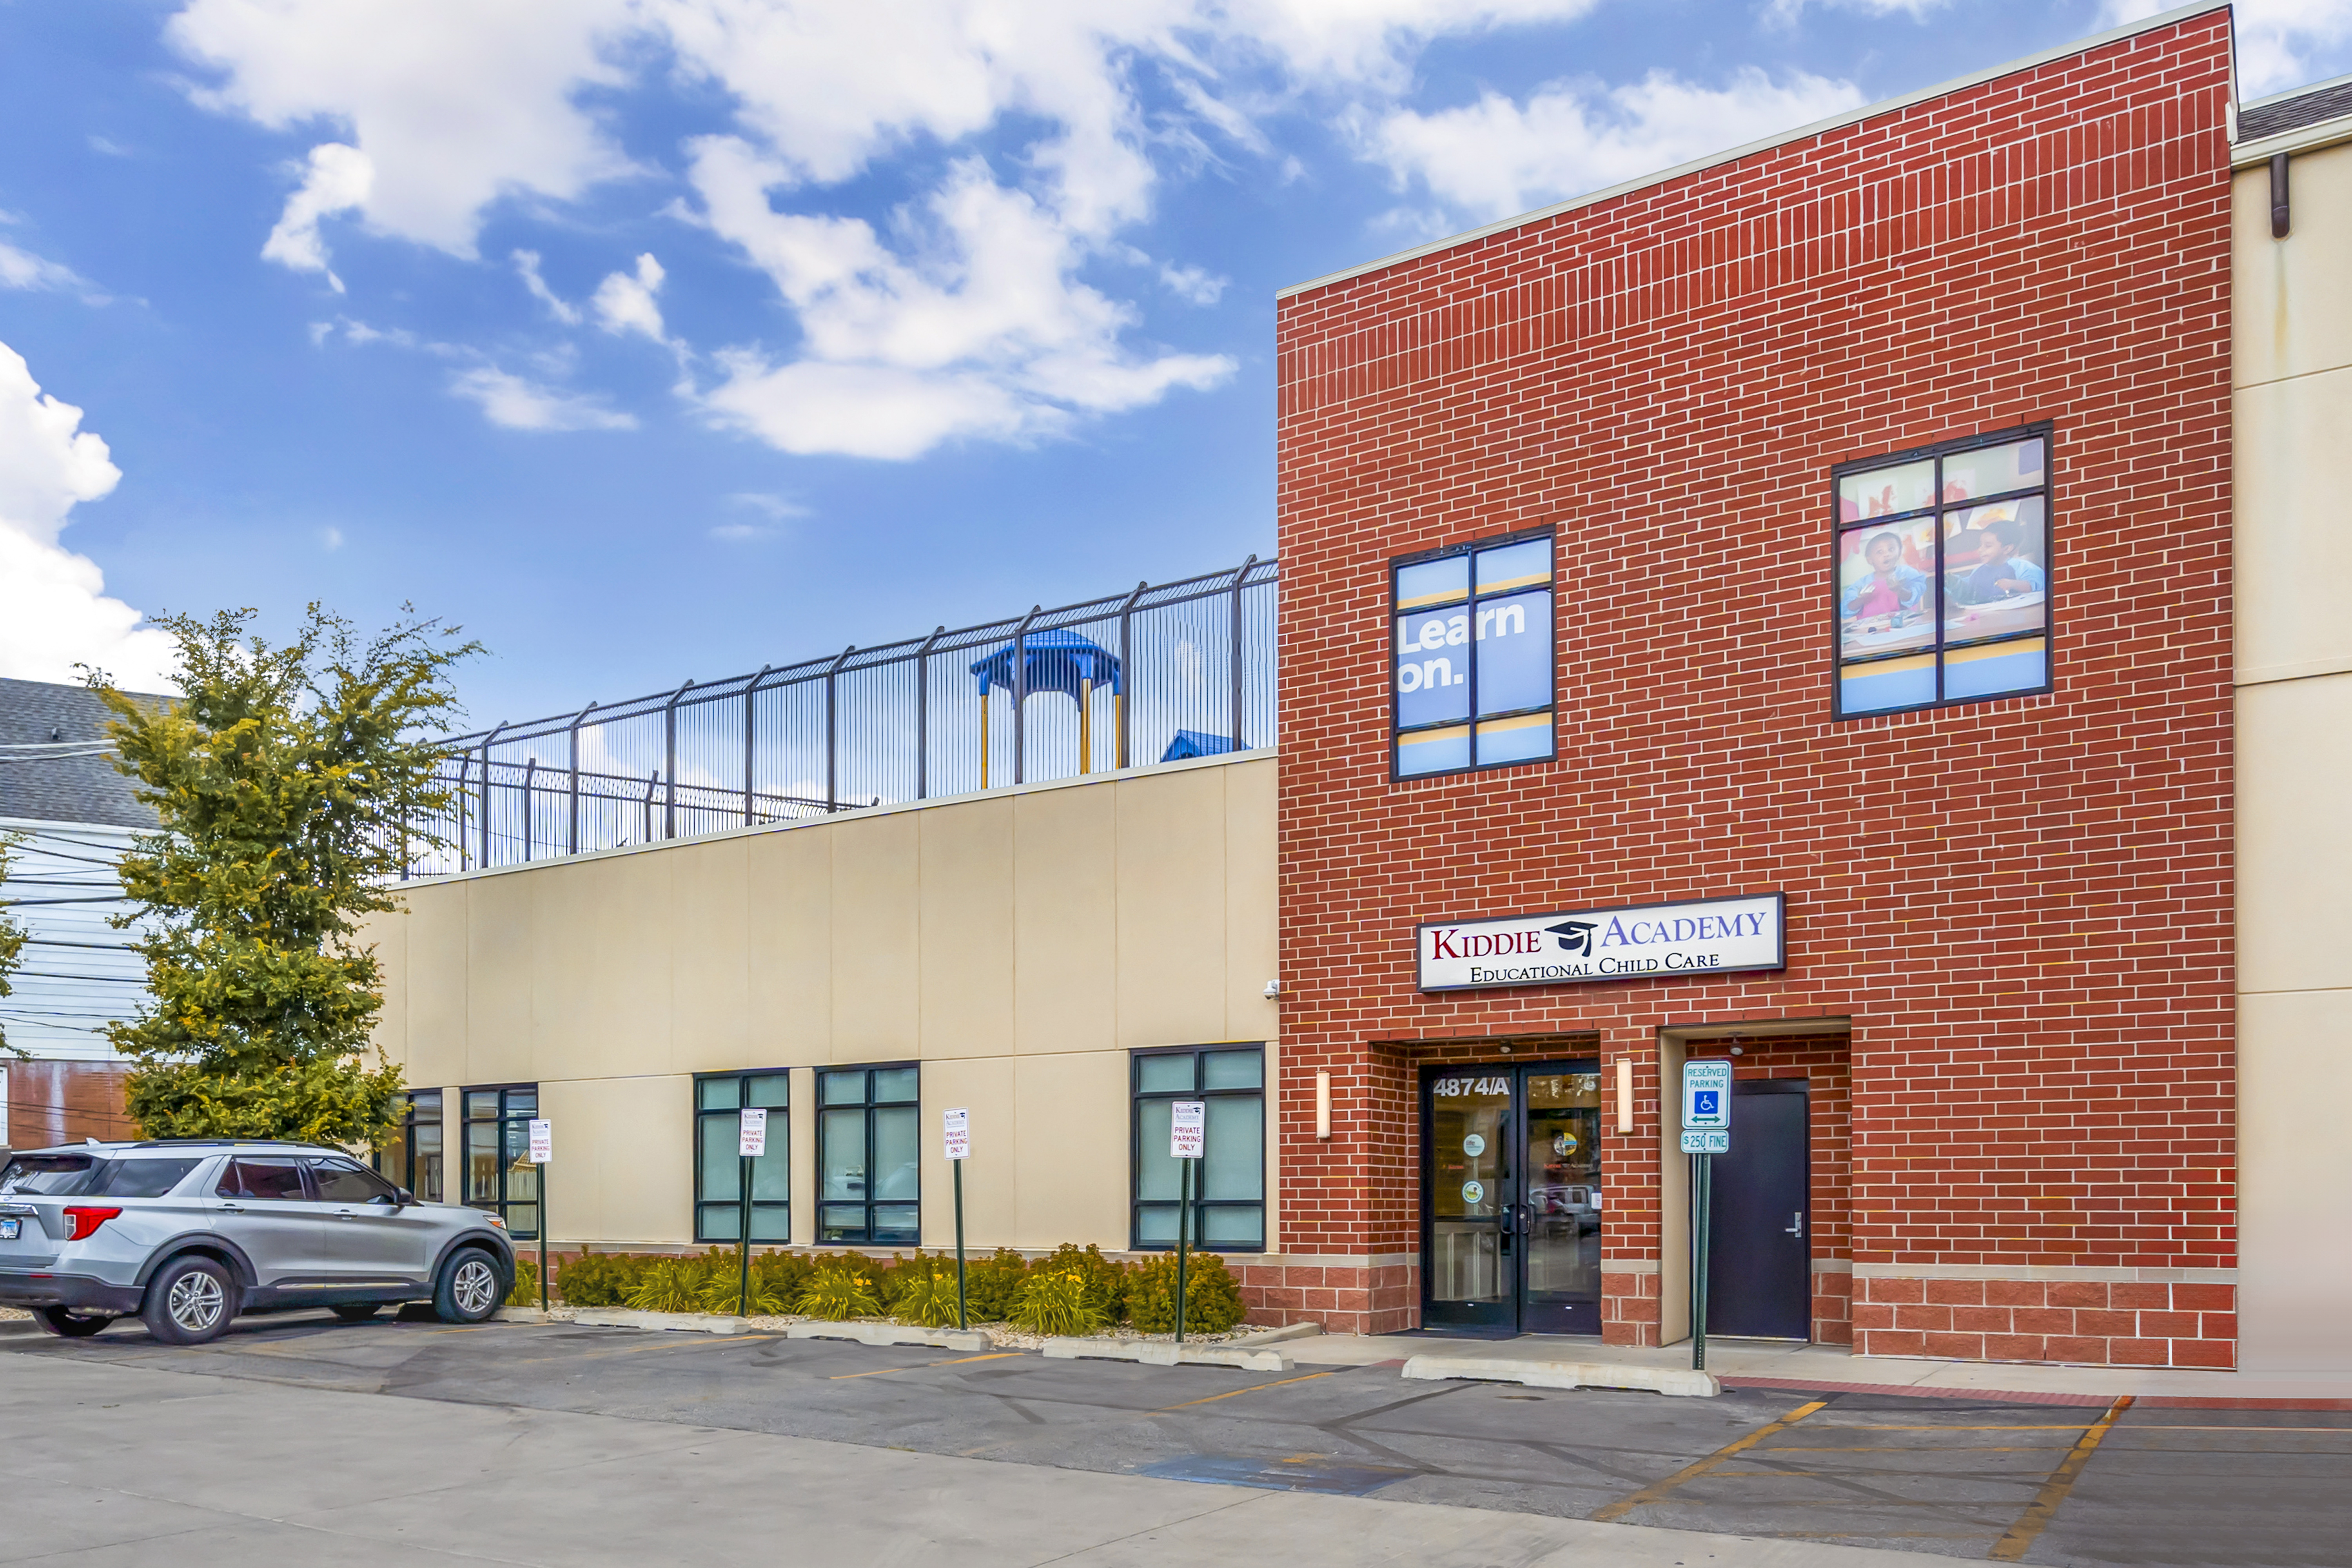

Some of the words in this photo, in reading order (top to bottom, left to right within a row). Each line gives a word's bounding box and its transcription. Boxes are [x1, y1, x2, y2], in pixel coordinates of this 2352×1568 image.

[1397, 604, 1525, 654] Learn
[1397, 657, 1464, 693] on.
[1432, 929, 1542, 960] KIDDIE
[1601, 912, 1767, 947] ACADEMY
[1470, 964, 1593, 982] EDUCATIONAL
[1599, 957, 1658, 973] CHILD
[1665, 953, 1720, 969] CARE
[1434, 1078, 1510, 1096] 4874/A
[1688, 1068, 1727, 1077] RESERVED
[1709, 1136, 1726, 1147] FINE
